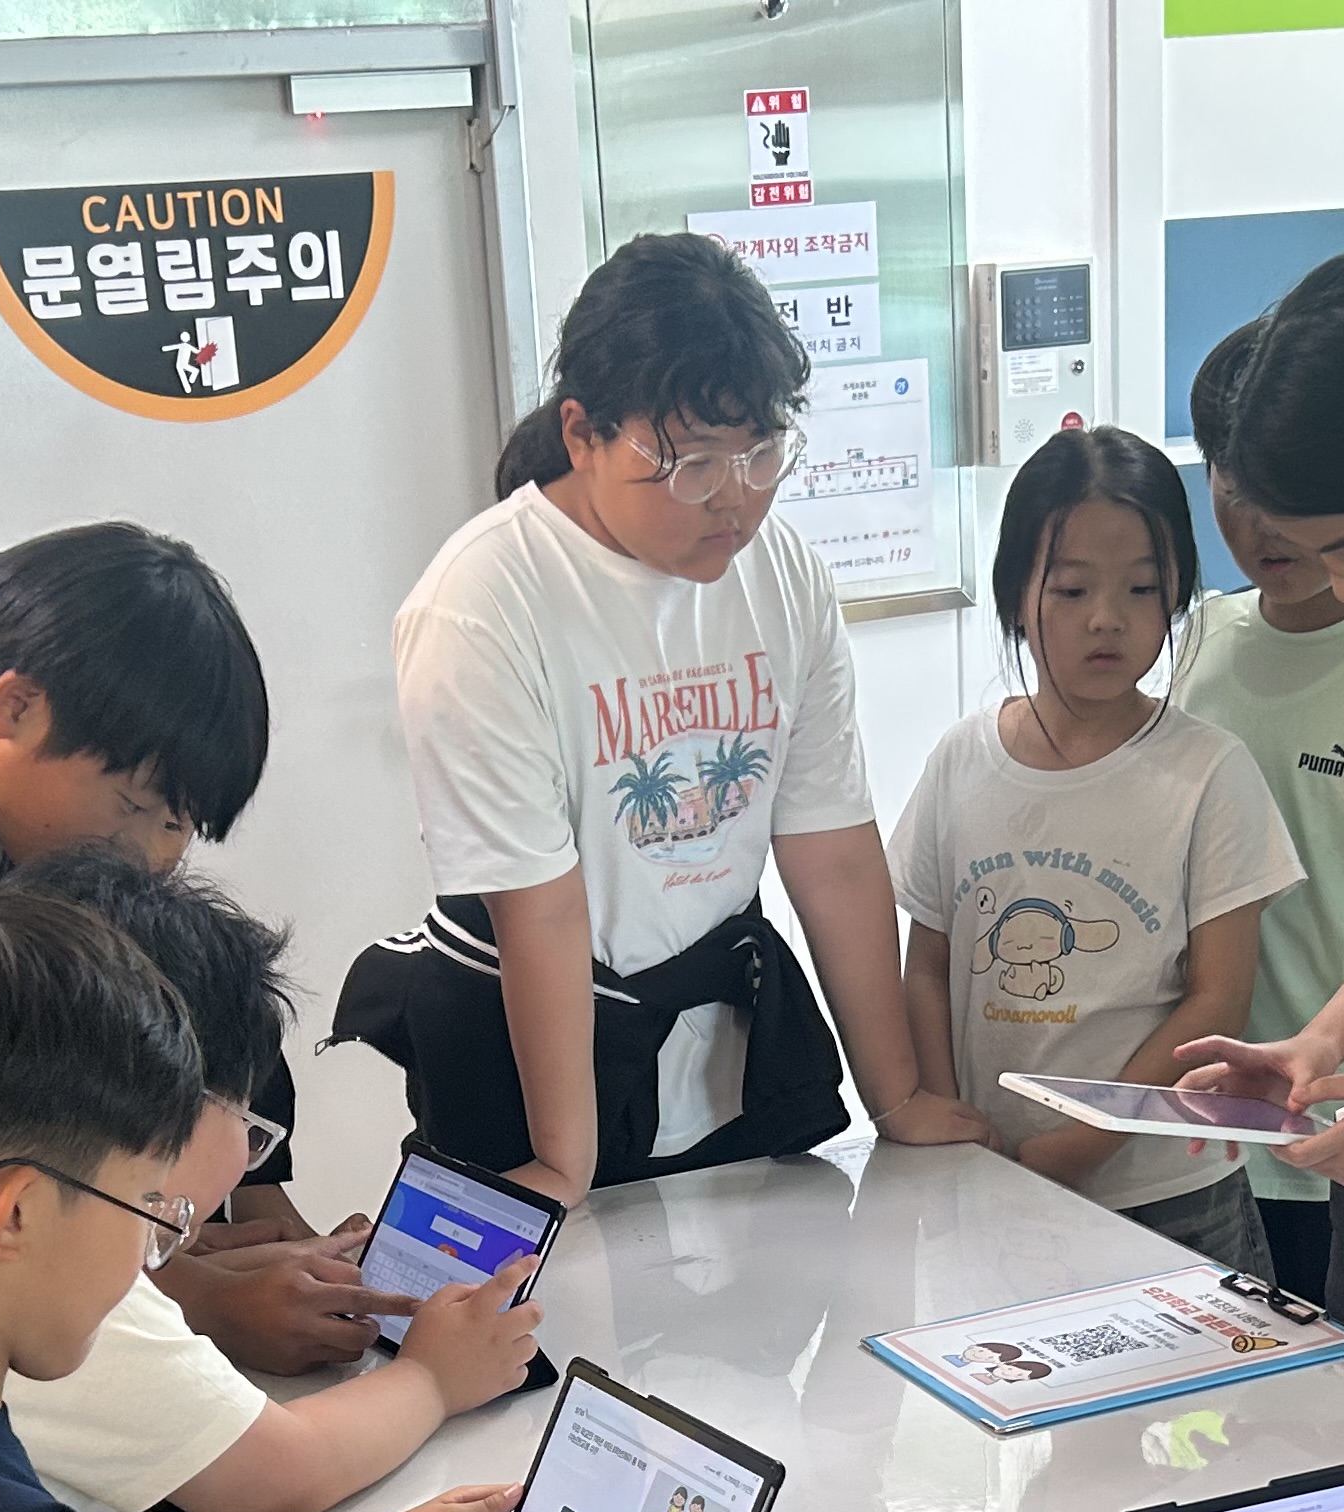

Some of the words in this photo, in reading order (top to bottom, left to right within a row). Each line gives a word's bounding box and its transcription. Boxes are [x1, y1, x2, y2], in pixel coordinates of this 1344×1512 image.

[81, 187, 285, 235] CAUTION
[804, 231, 869, 254] 조작금지
[21, 229, 346, 321] 문열림주의
[889, 547, 911, 562] 119
[588, 650, 779, 767] MAREILLE
[969, 850, 1015, 882] fun
[1022, 847, 1093, 878] with
[1094, 867, 1162, 935] music
